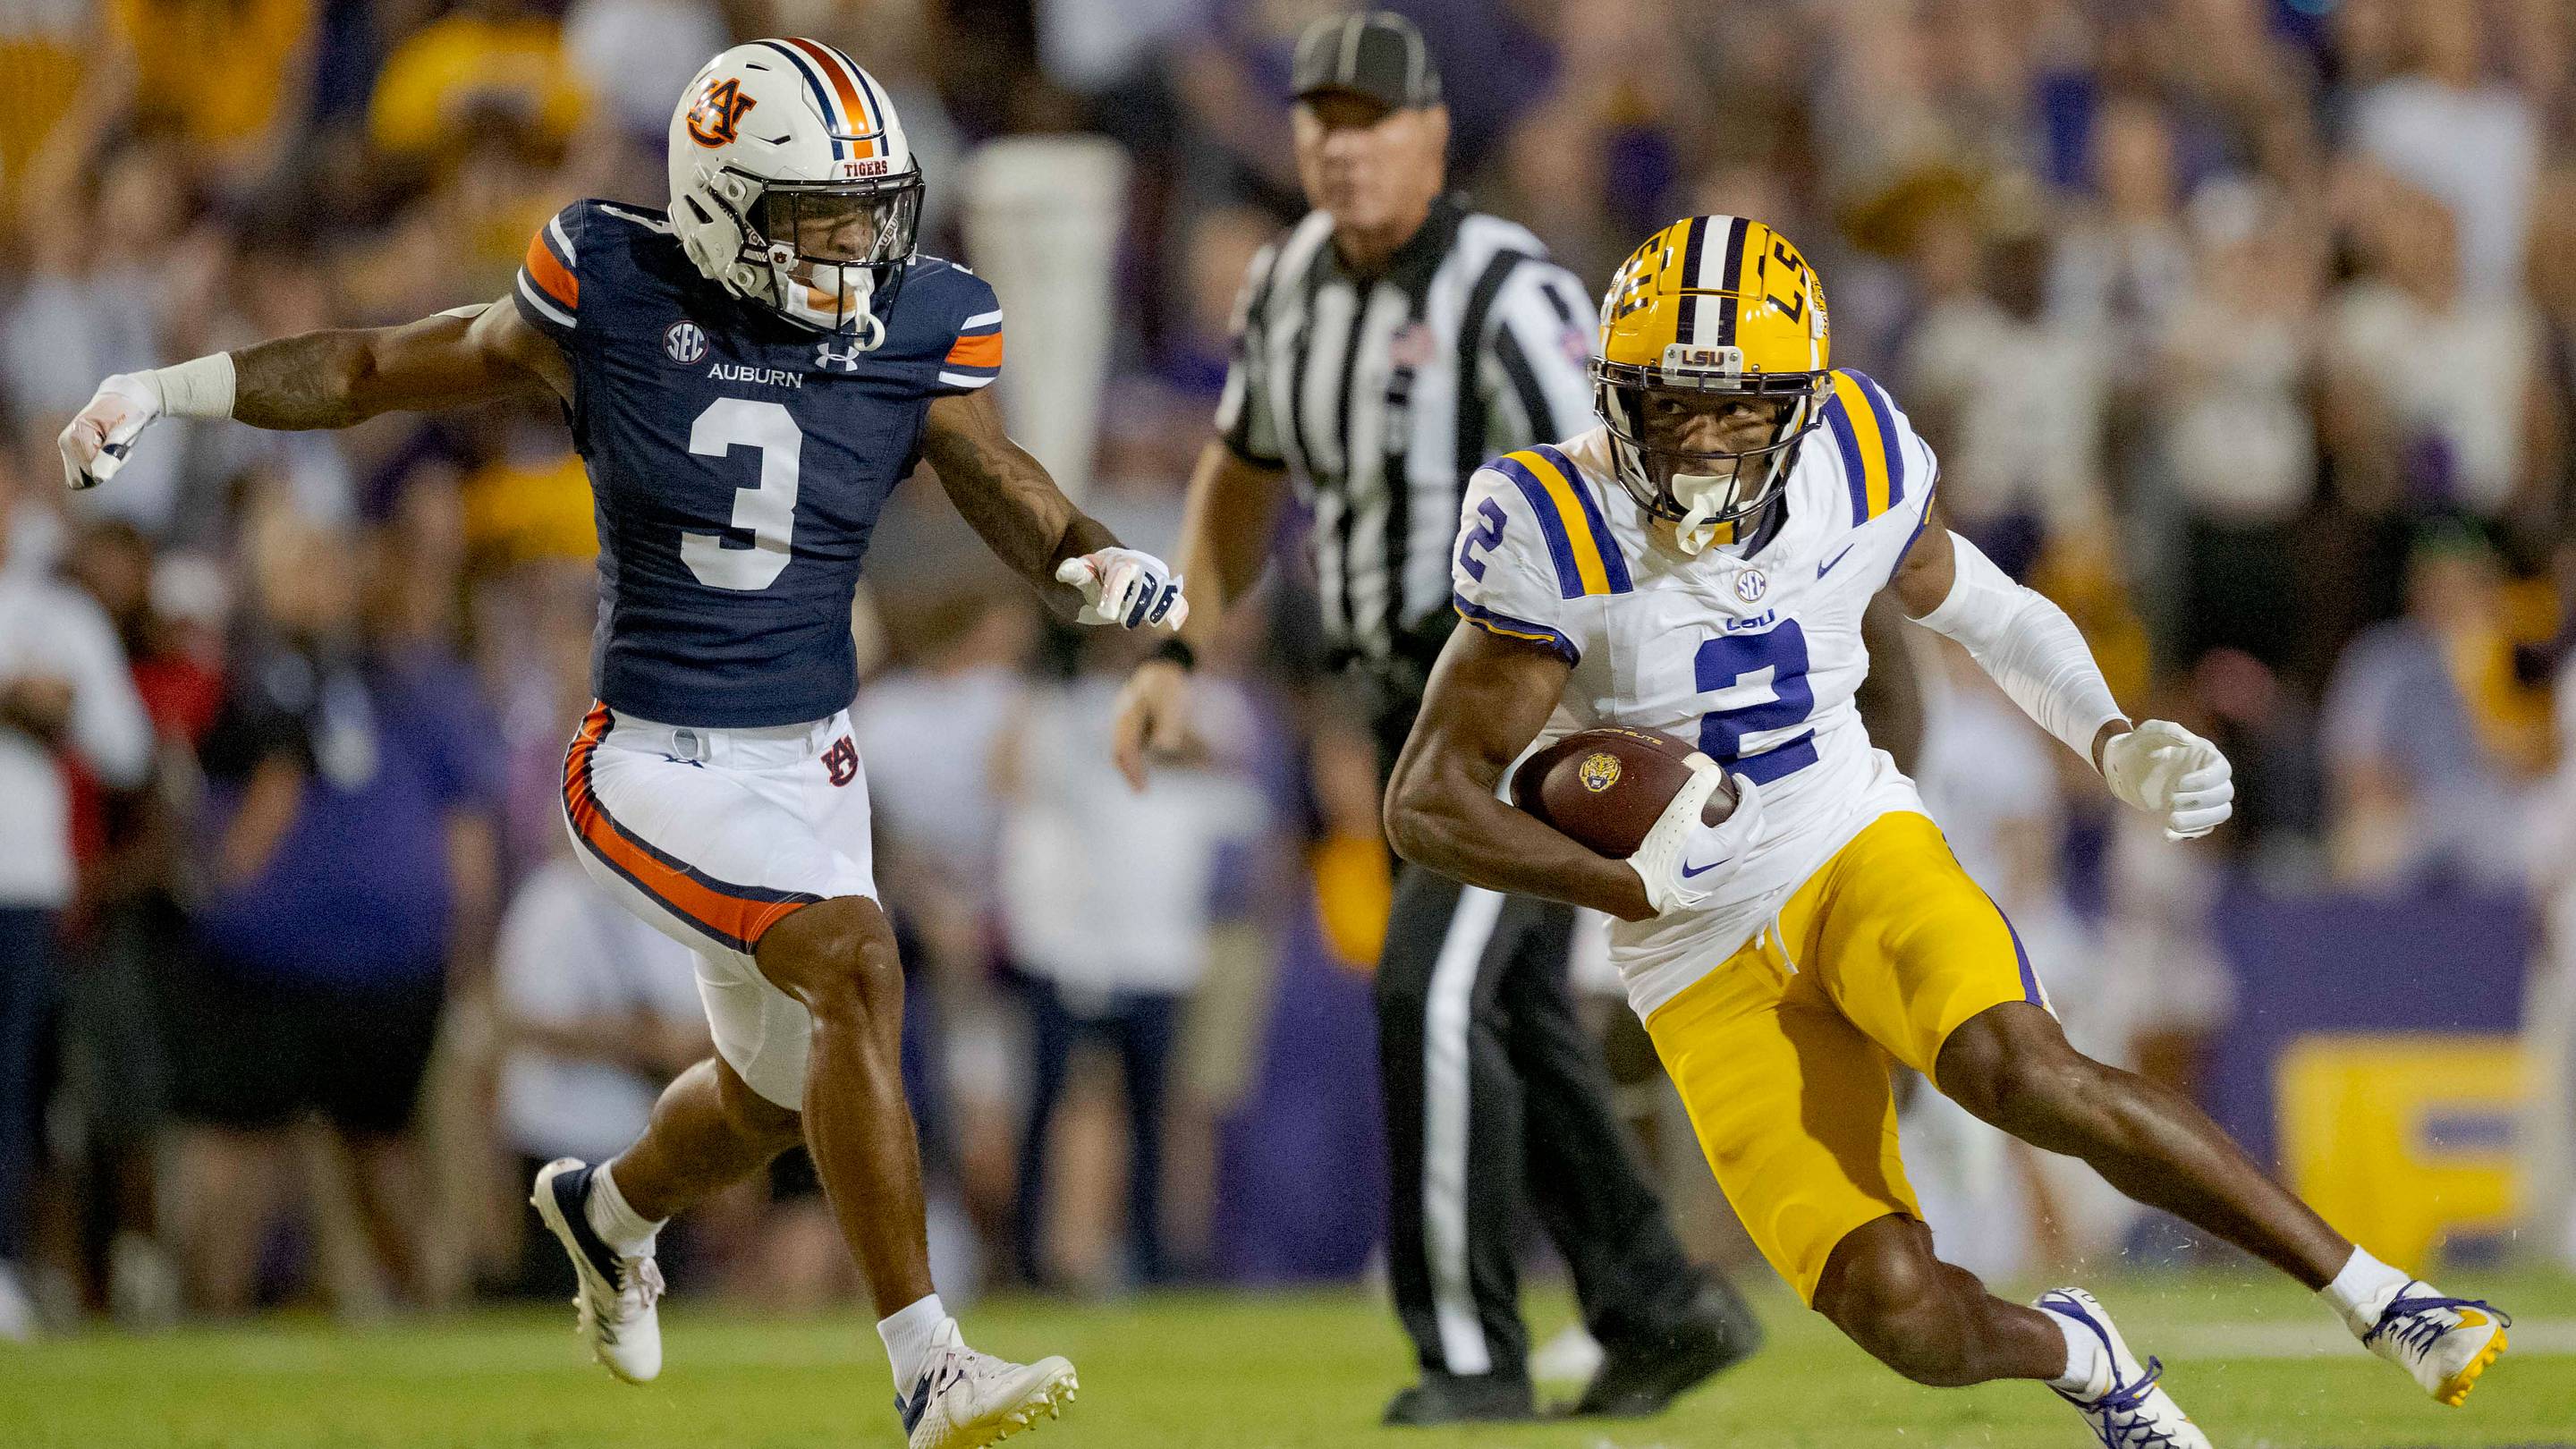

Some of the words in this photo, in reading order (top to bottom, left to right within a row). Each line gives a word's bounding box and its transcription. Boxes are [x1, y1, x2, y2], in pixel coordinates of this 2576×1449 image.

[843, 160, 888, 178] TIGERS
[1766, 241, 1806, 325] LS
[666, 323, 706, 362] SEC
[1682, 350, 1724, 367] LSU
[707, 363, 803, 389] AUBURN
[680, 396, 803, 591] 3
[1459, 496, 1508, 584] 2
[1737, 570, 1766, 601] SEC
[1694, 617, 1819, 787] 2
